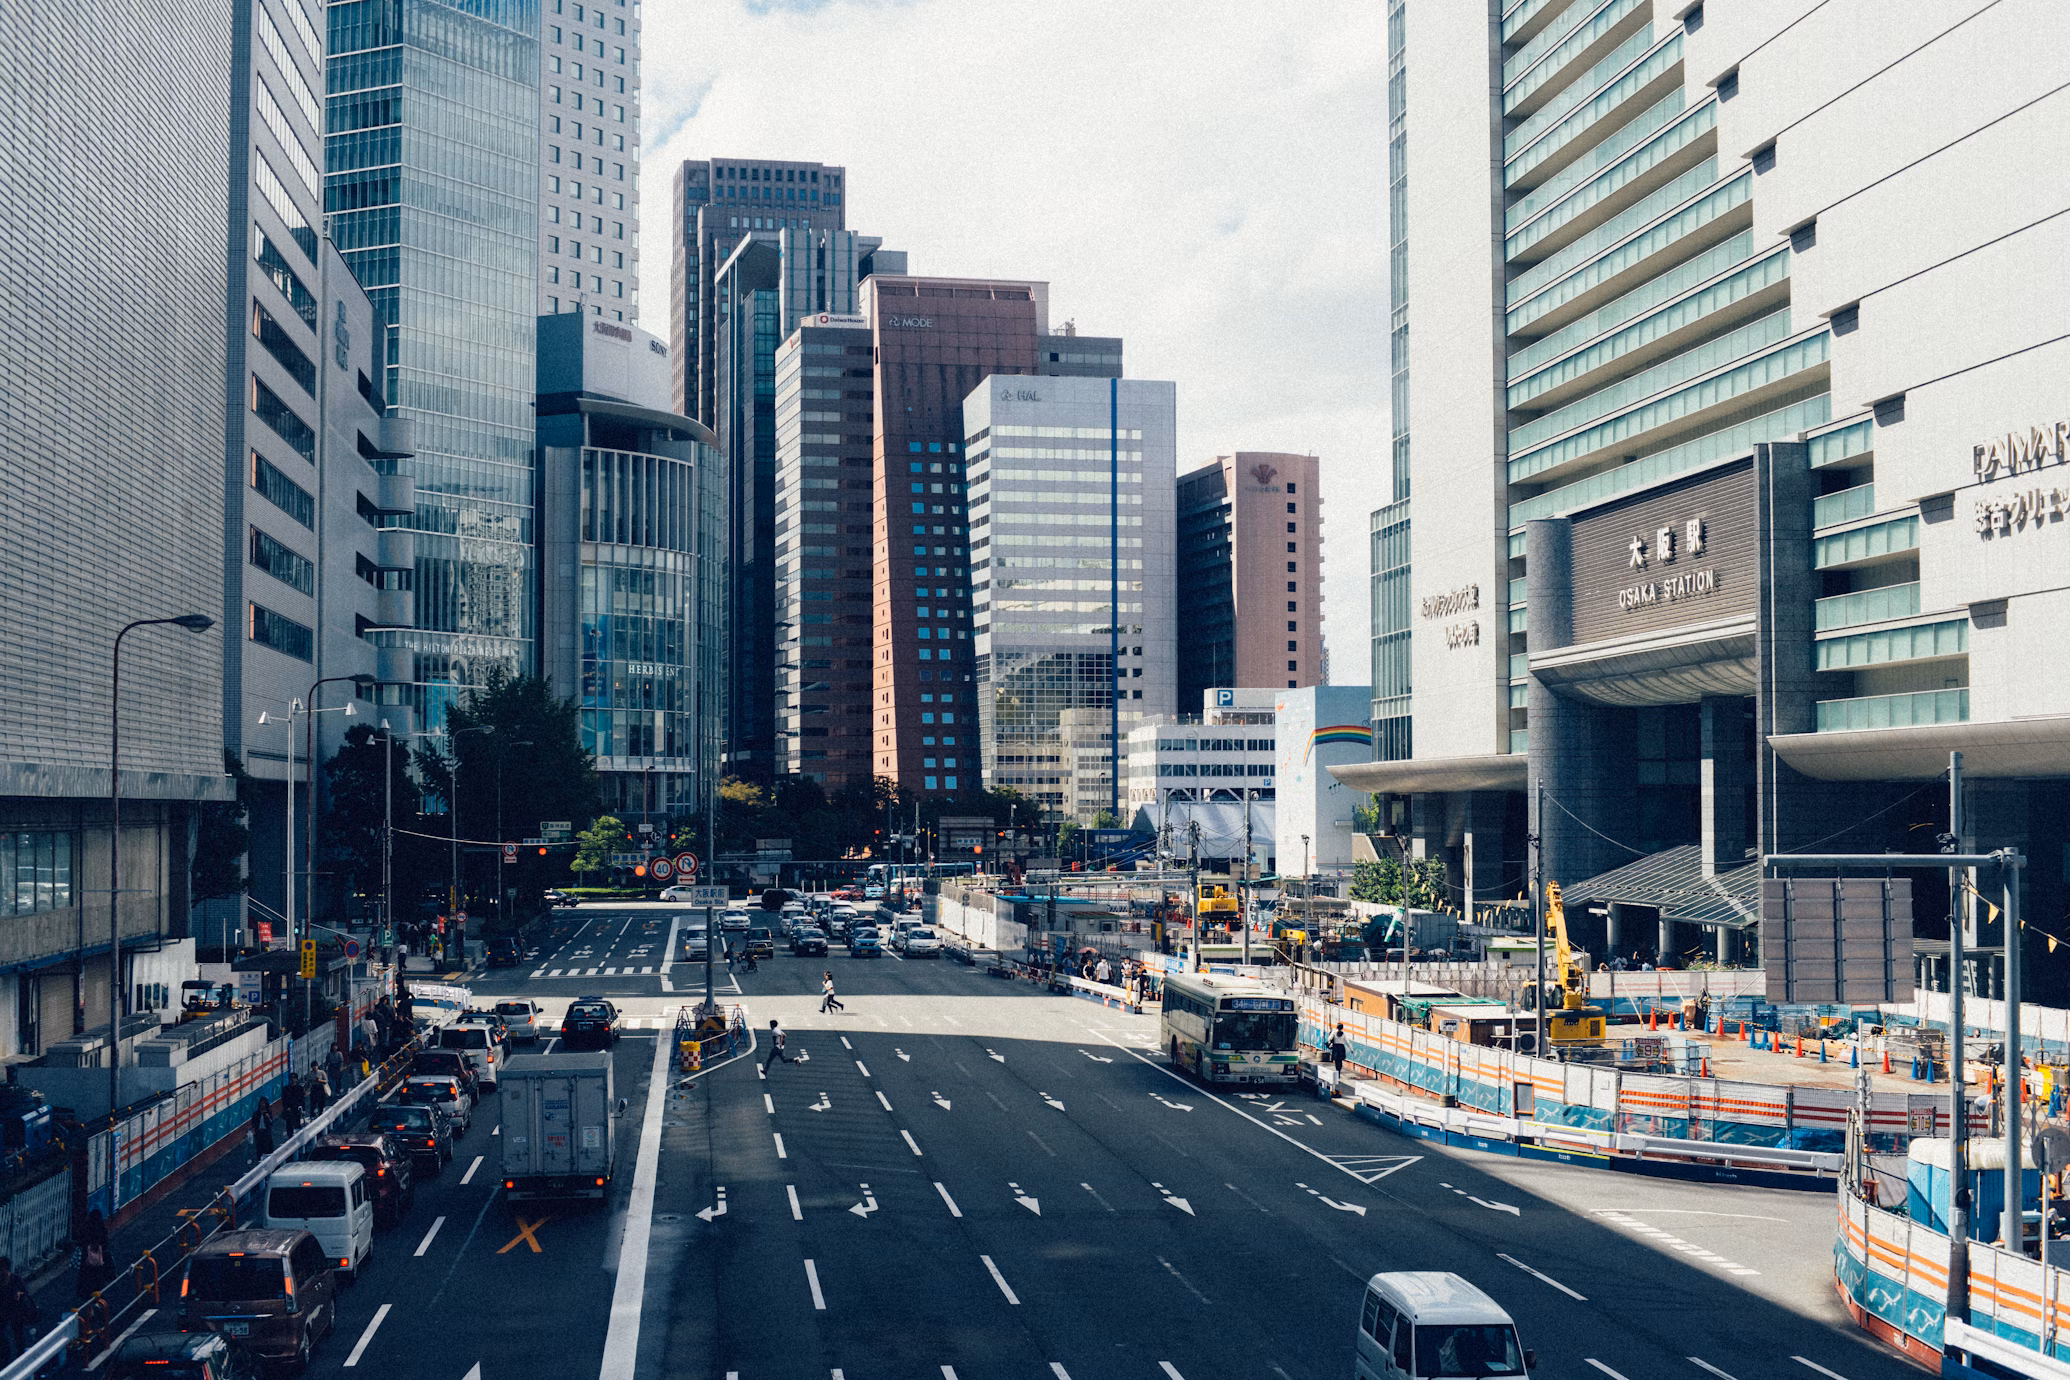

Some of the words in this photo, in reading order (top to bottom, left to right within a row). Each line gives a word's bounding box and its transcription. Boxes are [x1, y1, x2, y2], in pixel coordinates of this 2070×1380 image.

[902, 318, 932, 328] MODE
[650, 340, 668, 358] SONY
[1017, 390, 1041, 401] HAL
[1619, 583, 1657, 608] OSAKA
[1663, 568, 1715, 598] STATION
[628, 664, 662, 676] HERBIS
[1219, 691, 1232, 705] P
[656, 864, 669, 874] 40
[694, 888, 725, 898] 大阪駅前
